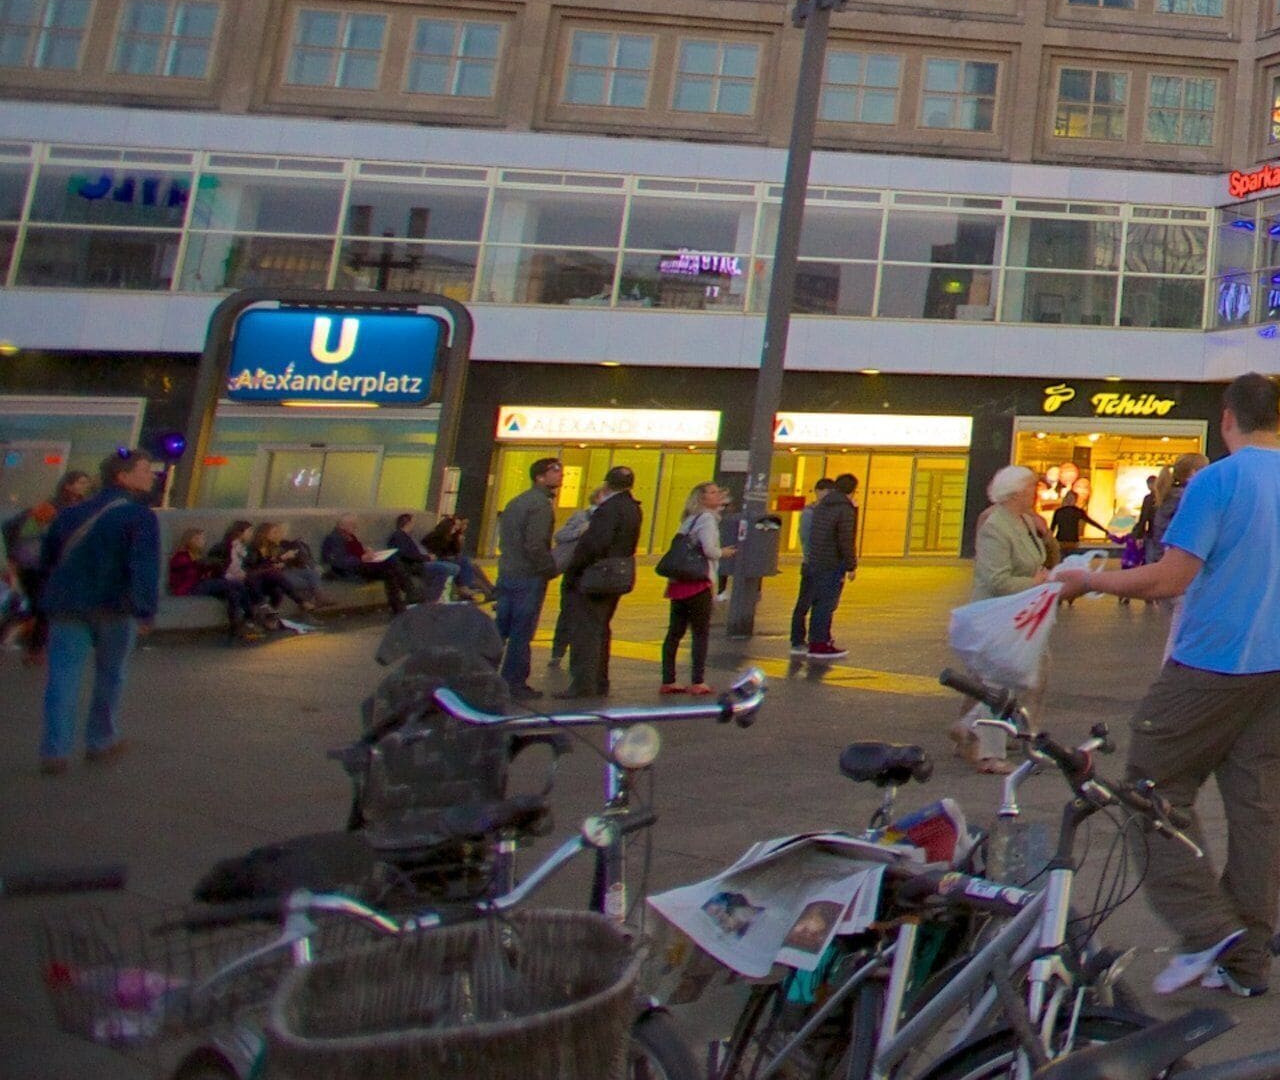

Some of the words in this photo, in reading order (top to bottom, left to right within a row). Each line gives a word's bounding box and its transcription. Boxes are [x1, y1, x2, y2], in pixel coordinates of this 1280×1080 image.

[310, 315, 360, 365] U
[237, 368, 423, 397] Alexanderplatz
[1091, 392, 1176, 416] Tchibo
